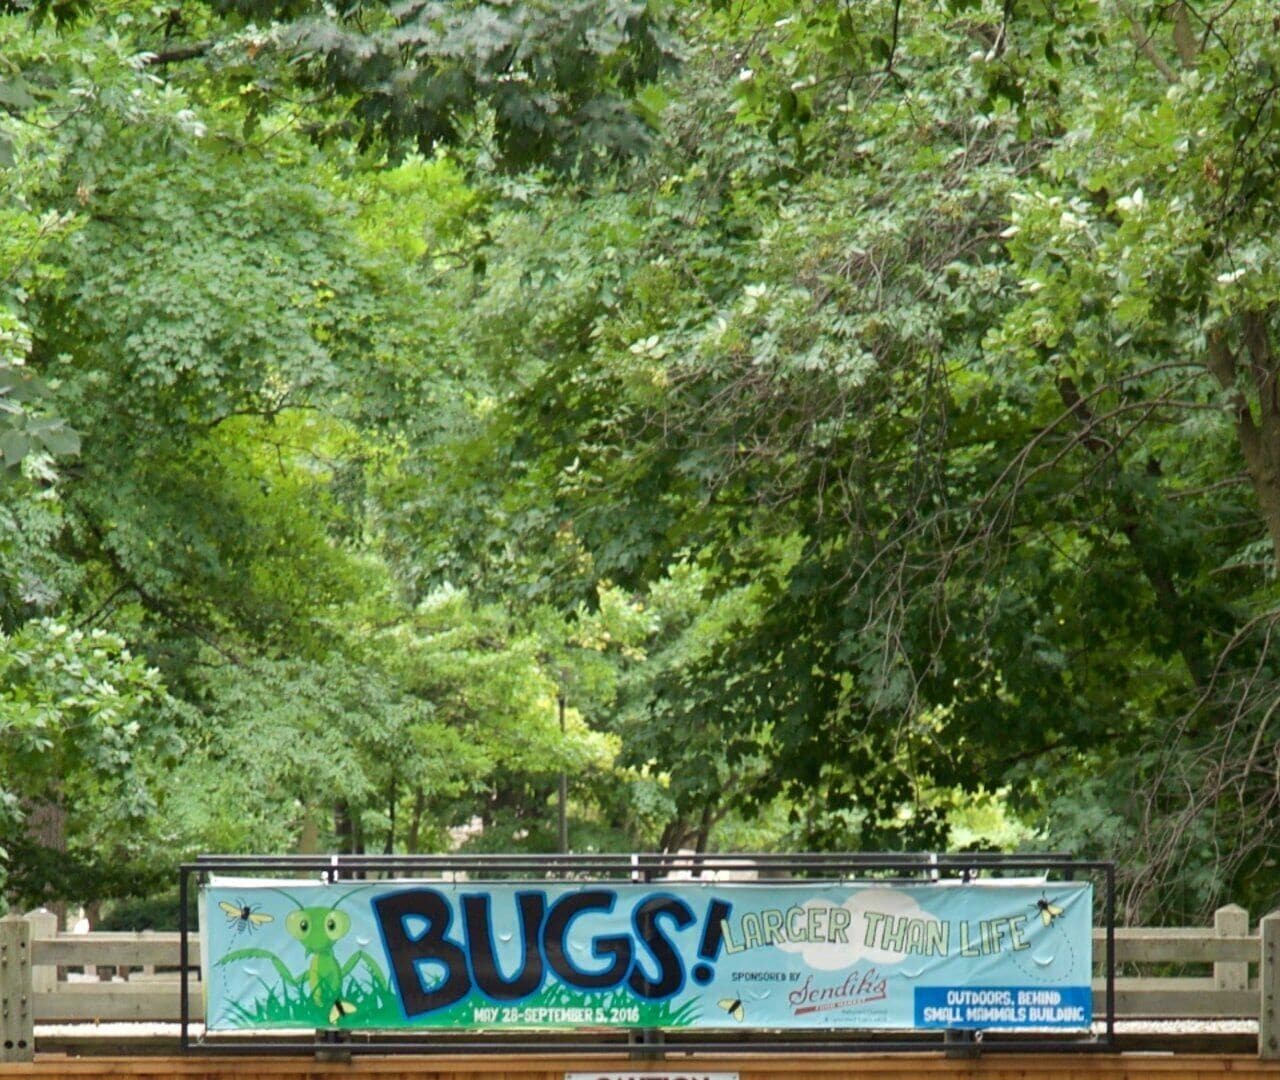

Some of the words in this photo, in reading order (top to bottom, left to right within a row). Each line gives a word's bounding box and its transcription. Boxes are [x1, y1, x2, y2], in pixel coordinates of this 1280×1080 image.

[720, 905, 851, 955] LARGER
[864, 912, 951, 957] THAN
[960, 914, 1031, 957] LIFE
[371, 887, 733, 1021] BUGS!
[731, 972, 786, 982] SPONSORED
[789, 972, 801, 982] BY
[788, 968, 887, 1008] Sendik's
[1018, 990, 1061, 1005] BEHIND
[474, 1007, 498, 1022] MAY
[502, 1007, 592, 1022] 28-SEPTEMBER
[610, 1006, 639, 1022] 2016
[923, 1007, 964, 1022] SMALL
[966, 1007, 1026, 1022] MAMMALS
[1029, 1006, 1084, 1022] BUILDING
